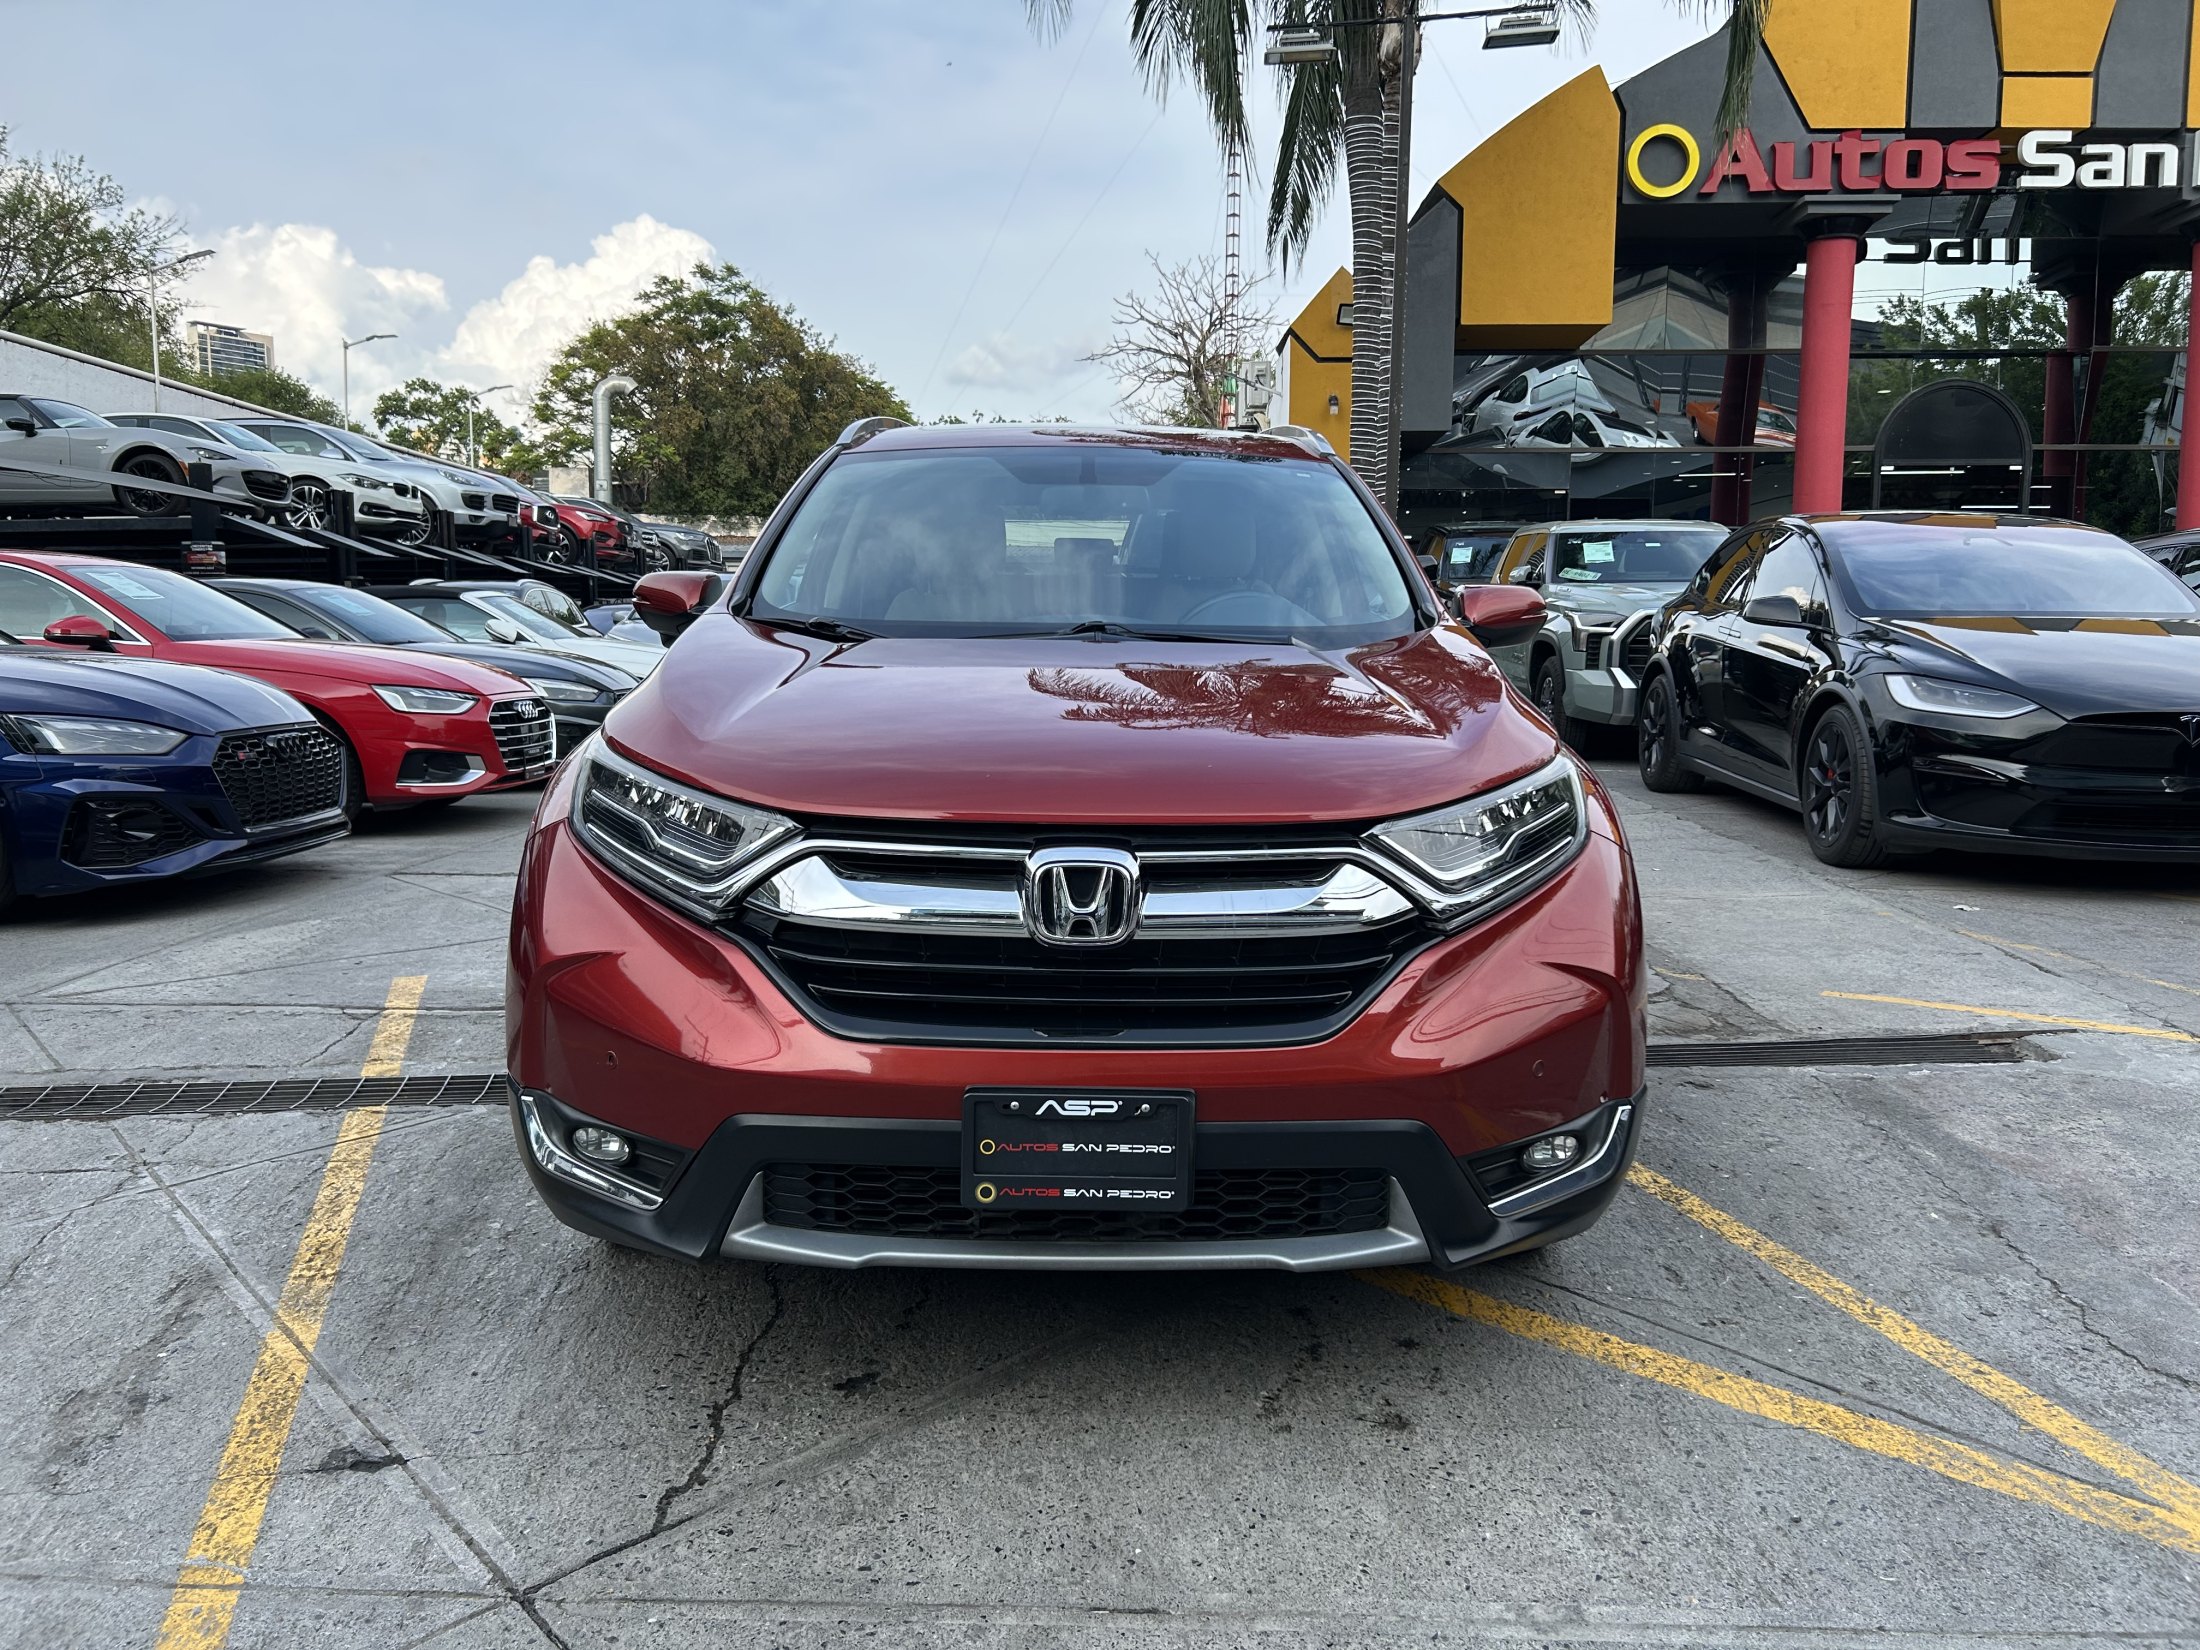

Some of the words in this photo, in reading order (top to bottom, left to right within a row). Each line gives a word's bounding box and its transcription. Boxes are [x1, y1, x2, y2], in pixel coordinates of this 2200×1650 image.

[1698, 128, 2001, 194] Autos
[2016, 130, 2179, 190] San
[996, 1143, 1059, 1152] AUTOS
[1061, 1143, 1103, 1153] SAN
[999, 1187, 1061, 1197] AUTOS
[1063, 1188, 1103, 1198] SAN
